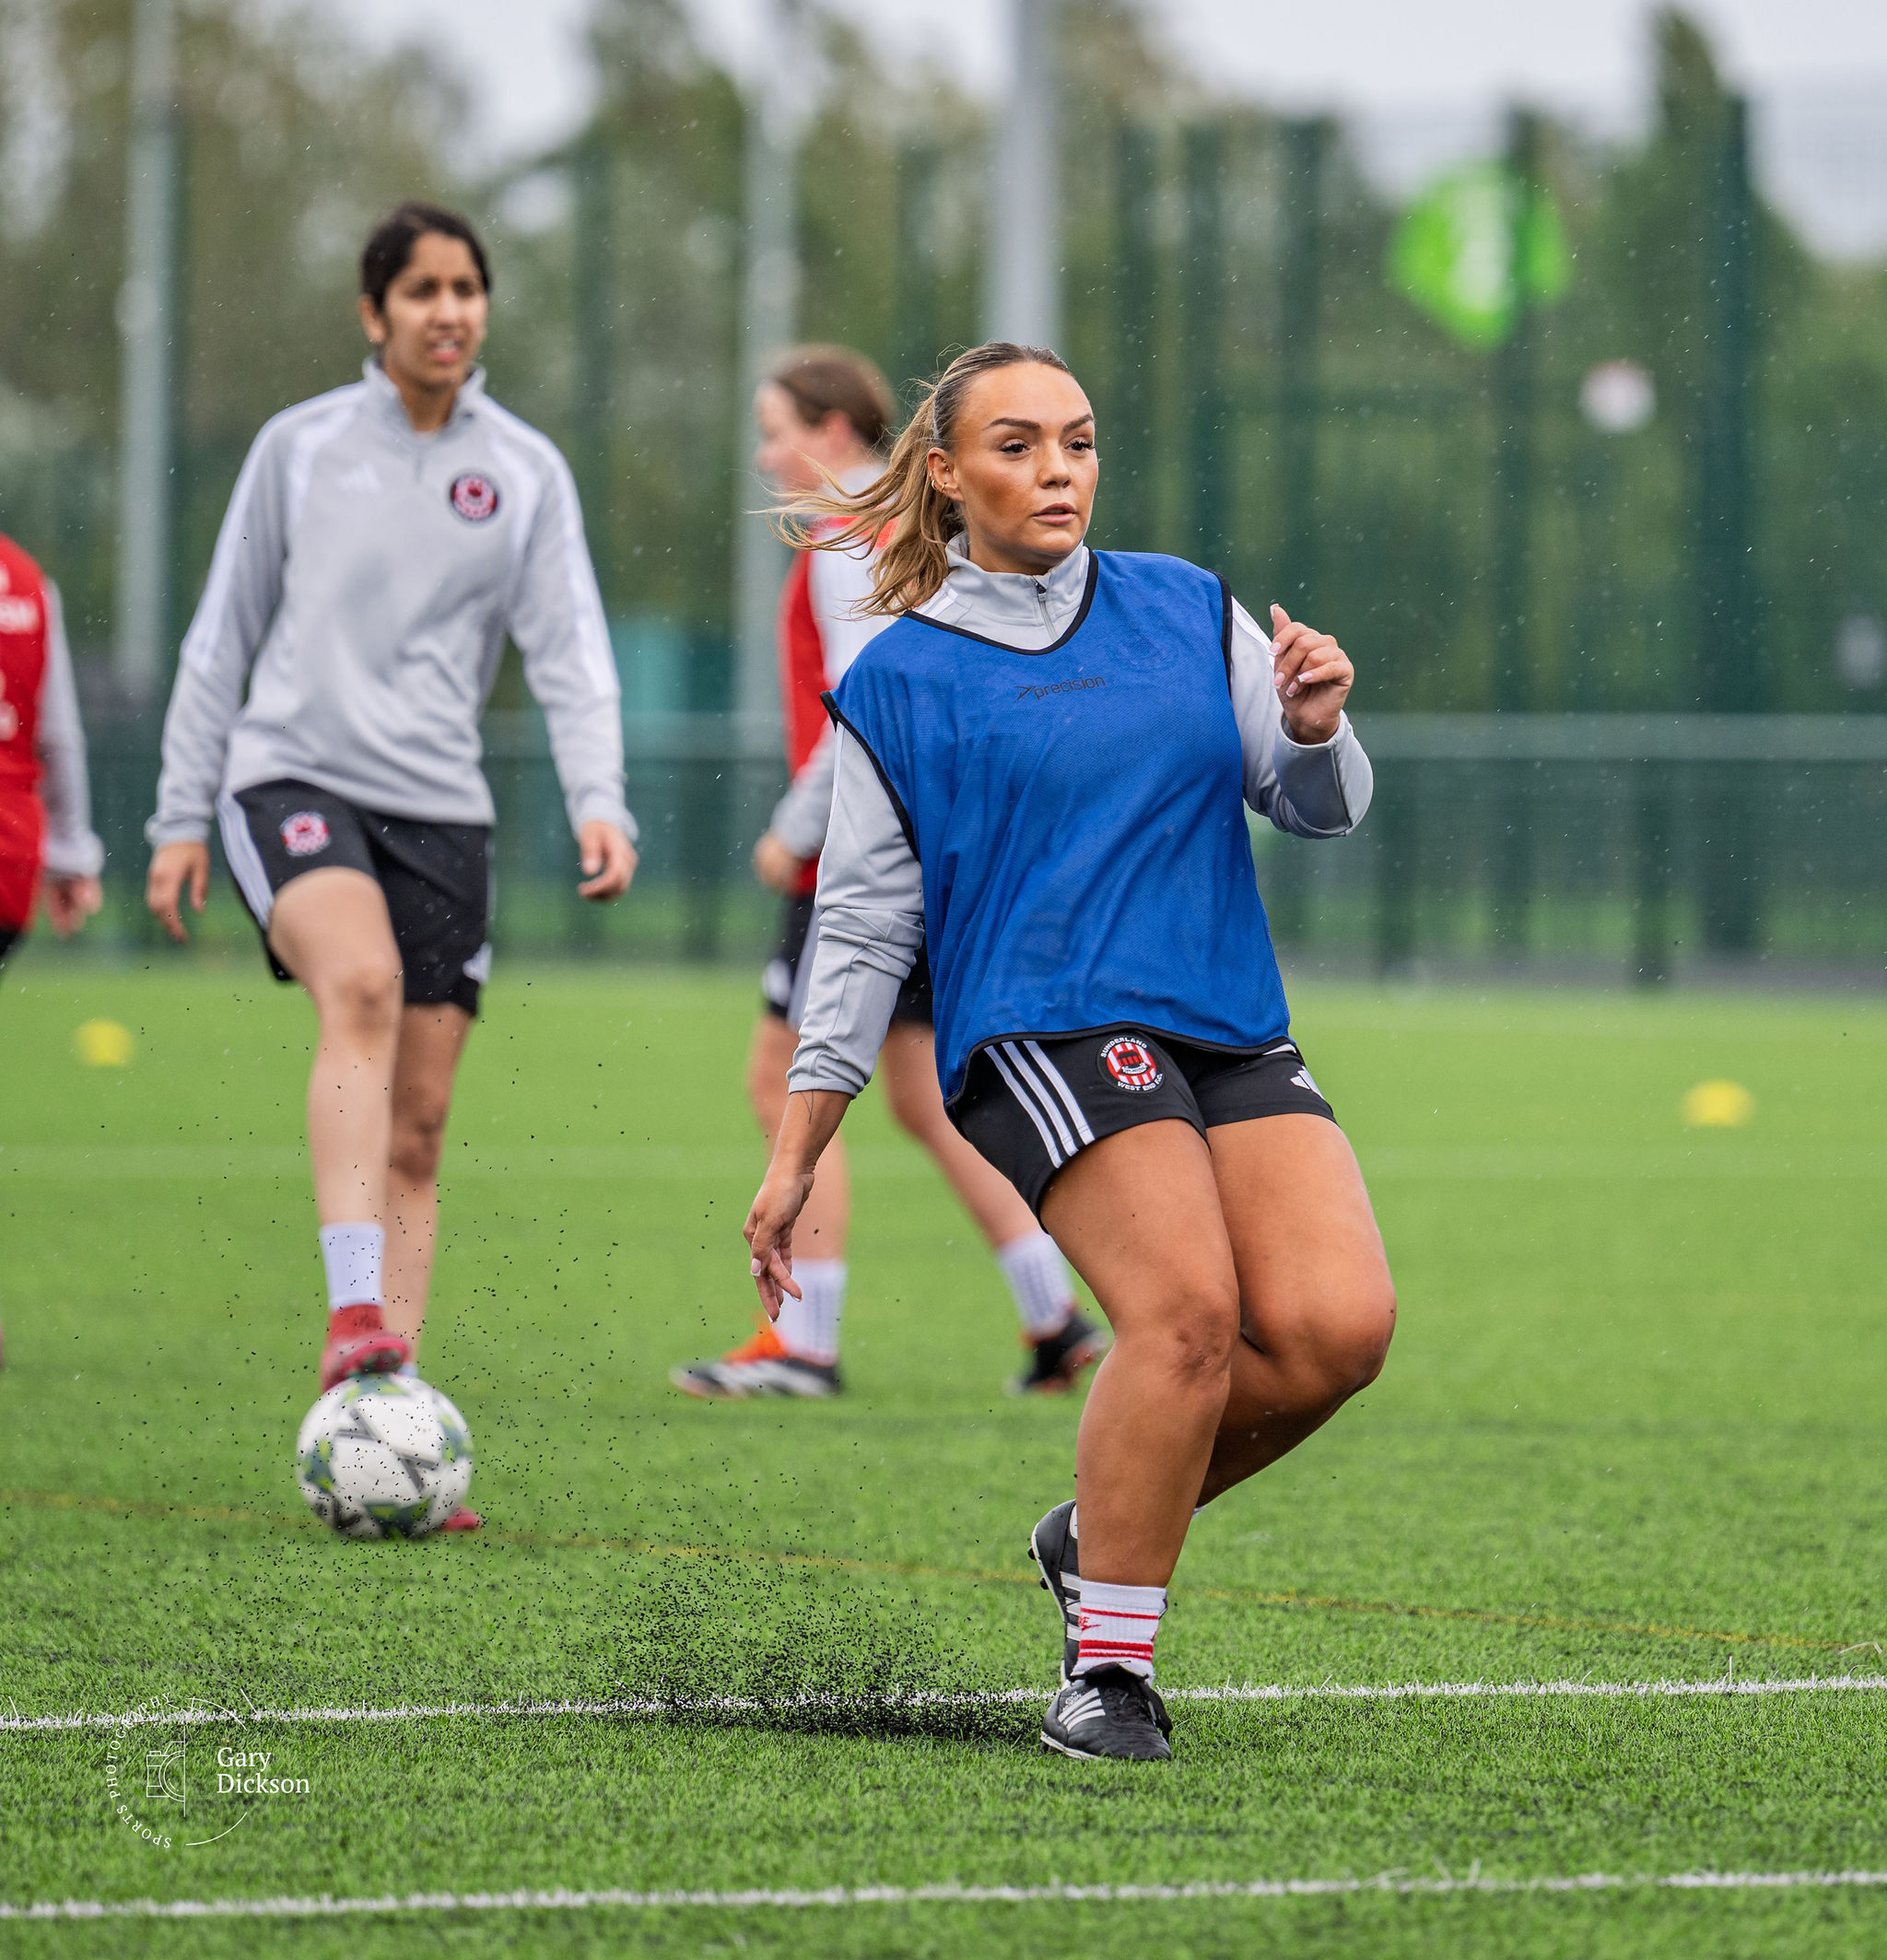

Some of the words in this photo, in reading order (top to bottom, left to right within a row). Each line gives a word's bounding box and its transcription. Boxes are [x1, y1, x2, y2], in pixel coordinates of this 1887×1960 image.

[1034, 675, 1107, 700] precision
[1100, 1037, 1148, 1058] SUNDERLAND
[1117, 1080, 1142, 1091] WEST
